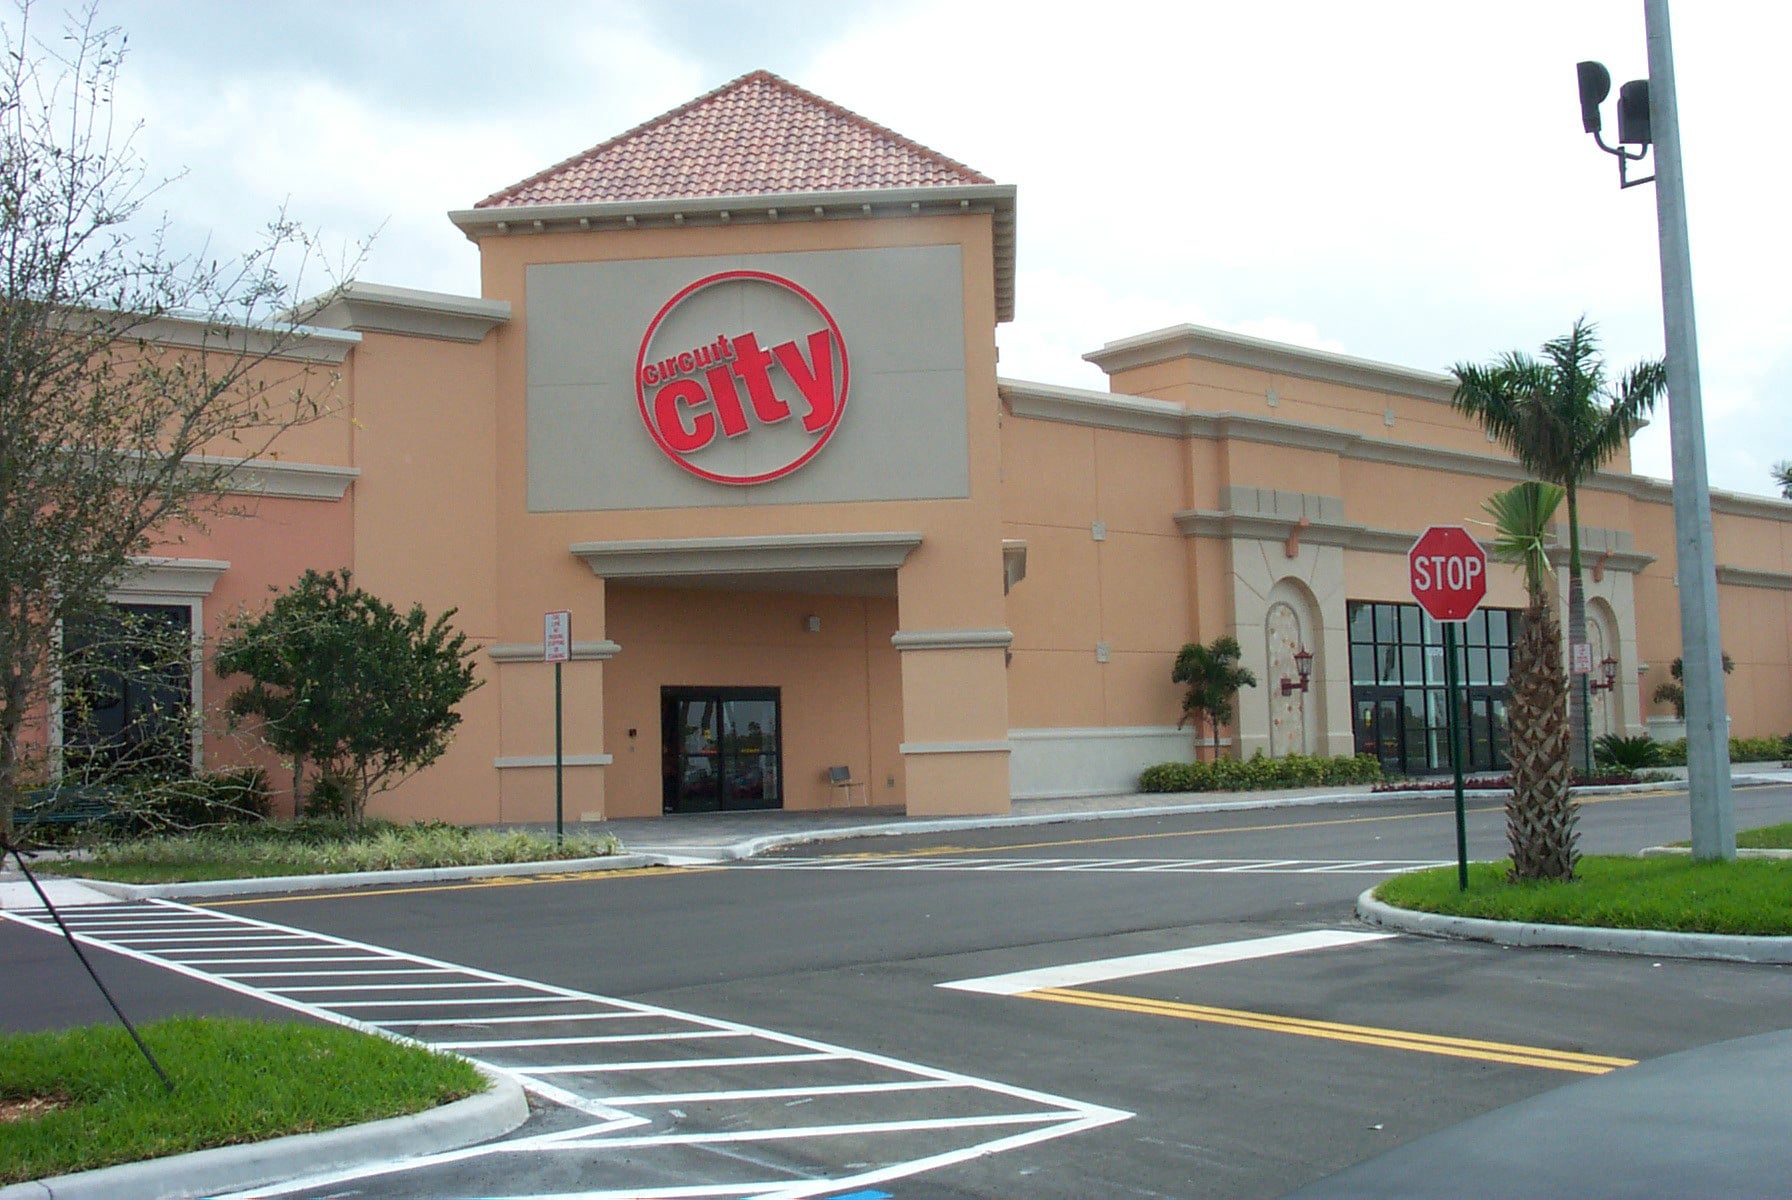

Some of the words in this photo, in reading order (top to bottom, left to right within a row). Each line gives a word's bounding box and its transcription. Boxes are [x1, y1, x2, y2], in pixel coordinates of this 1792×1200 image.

[642, 334, 733, 384] circuit
[653, 328, 836, 453] city
[1414, 555, 1482, 591] STOP
